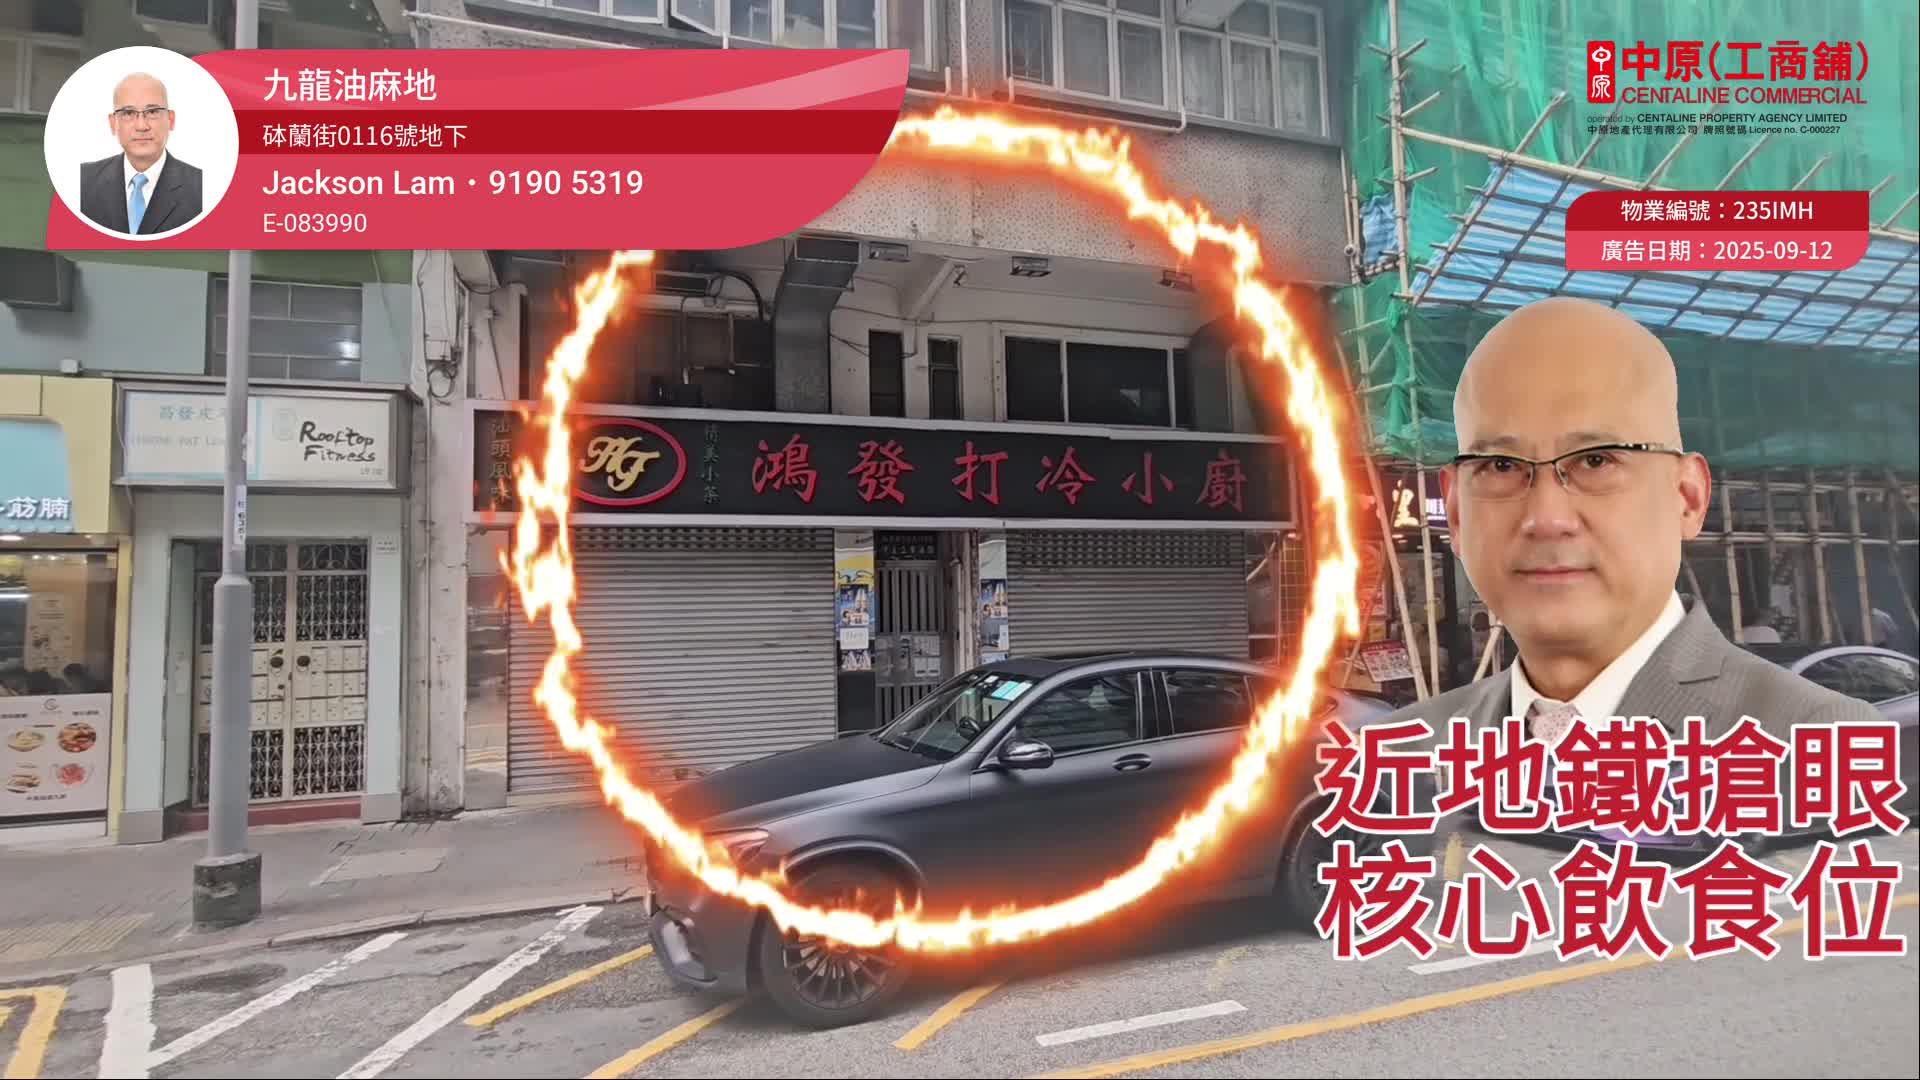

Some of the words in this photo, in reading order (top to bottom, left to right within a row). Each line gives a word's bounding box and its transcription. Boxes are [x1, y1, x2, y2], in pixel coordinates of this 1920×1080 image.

[300, 421, 375, 447] Rooftop
[304, 445, 376, 462] Fitness
[750, 433, 1248, 513] 鴻發打冷小廚
[0, 496, 70, 518] 筋腩
